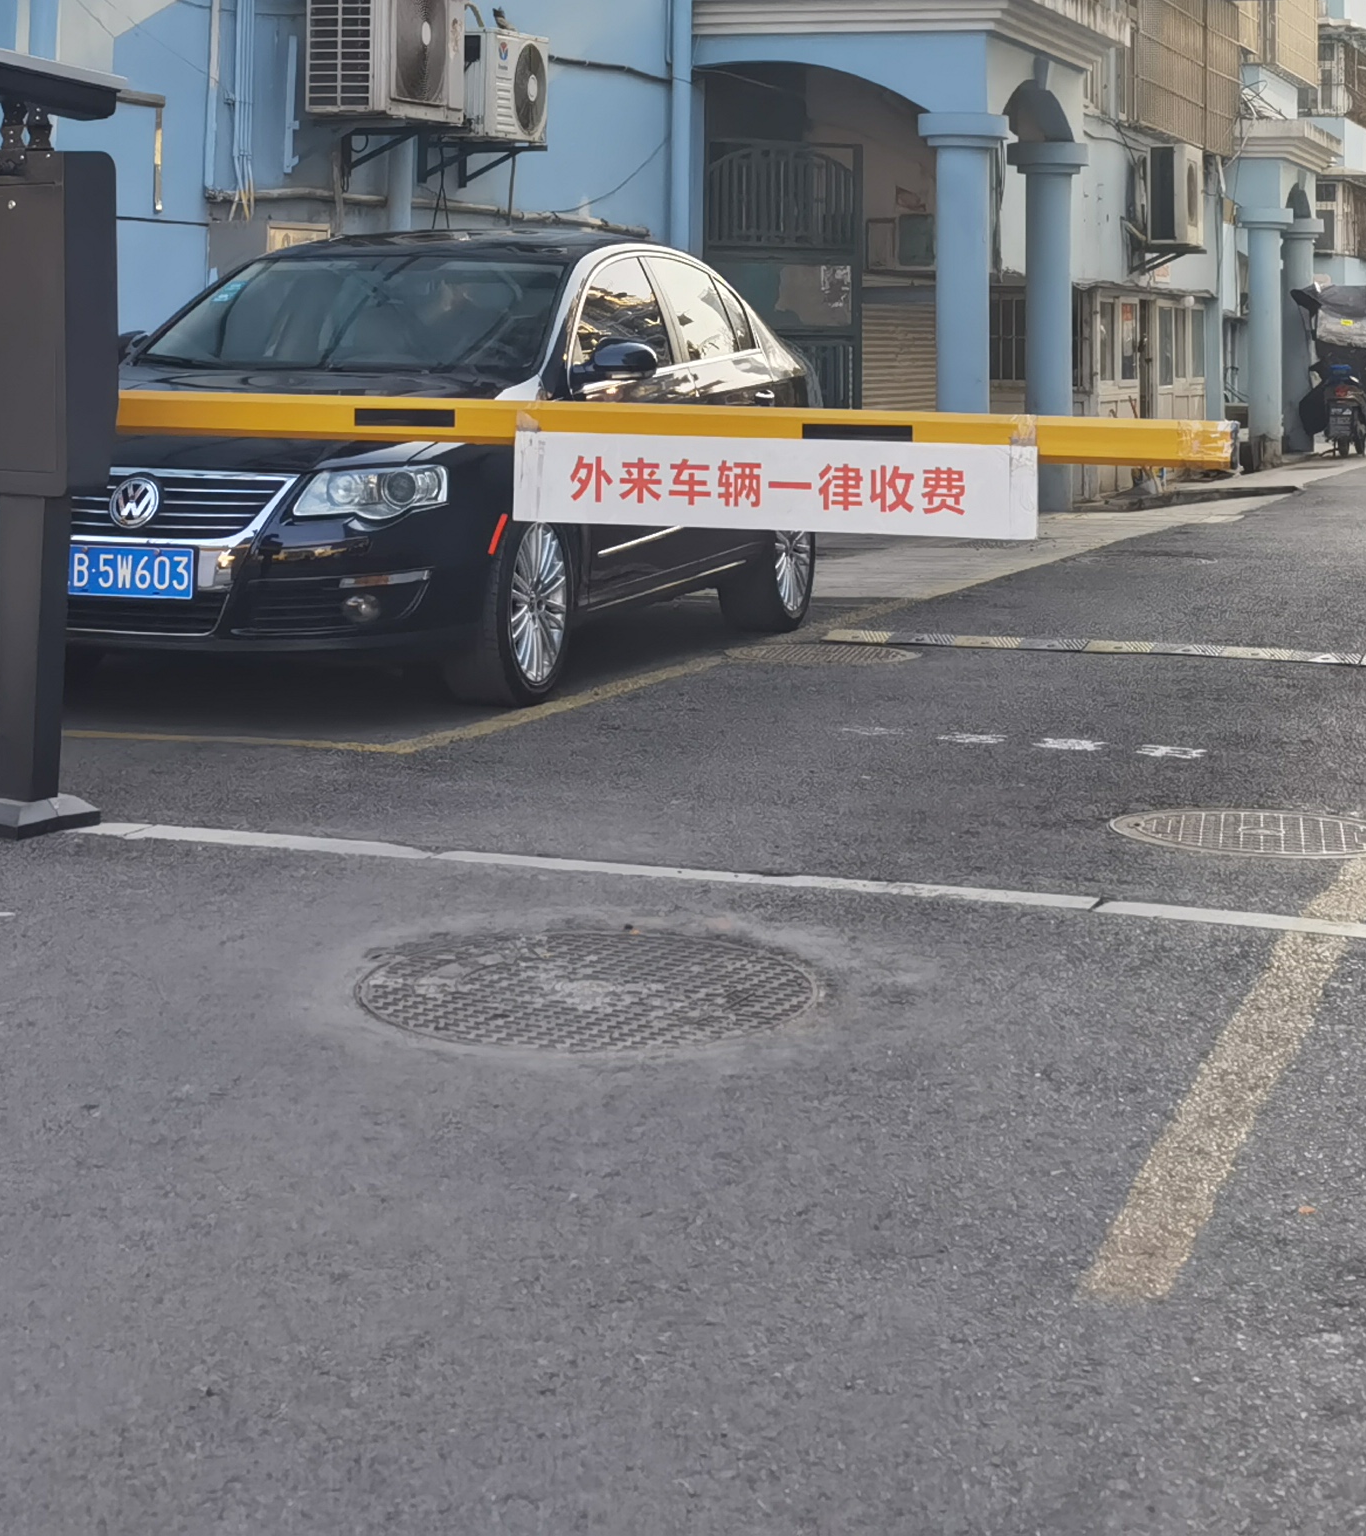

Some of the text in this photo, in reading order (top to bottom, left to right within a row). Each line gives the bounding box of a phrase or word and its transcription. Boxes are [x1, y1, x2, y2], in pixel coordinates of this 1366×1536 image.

[569, 454, 966, 515] 外来车辆一律收费
[68, 552, 189, 591] B·5W603
